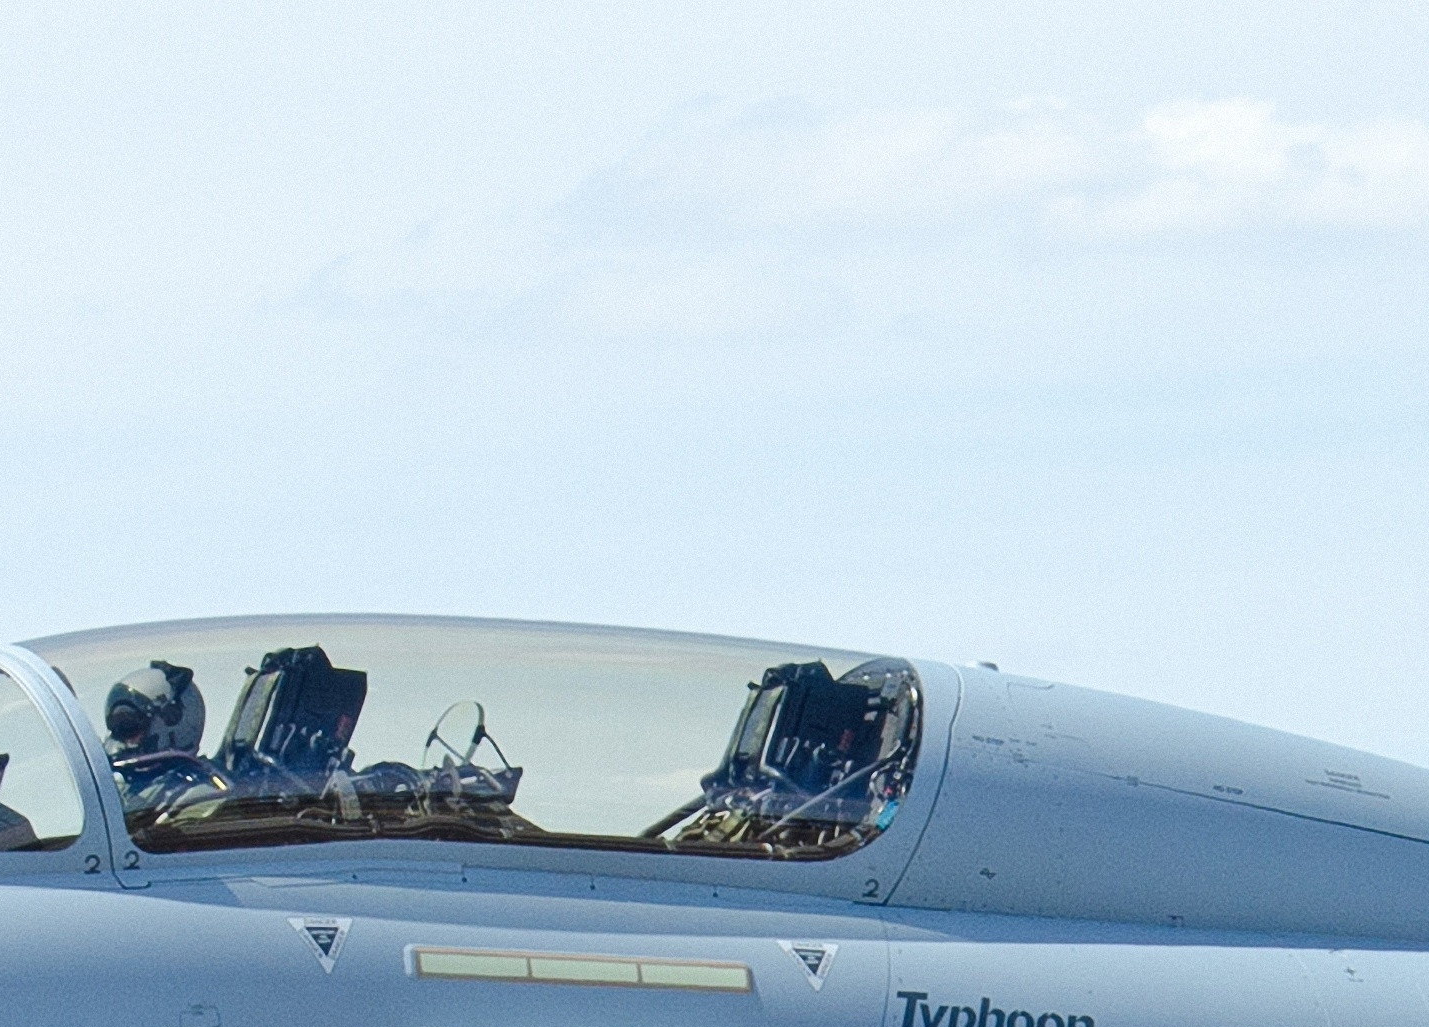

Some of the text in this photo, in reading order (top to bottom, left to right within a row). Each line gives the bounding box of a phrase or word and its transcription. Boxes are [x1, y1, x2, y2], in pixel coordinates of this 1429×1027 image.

[84, 854, 101, 875] 2
[123, 850, 141, 871] 2
[862, 878, 879, 899] 2
